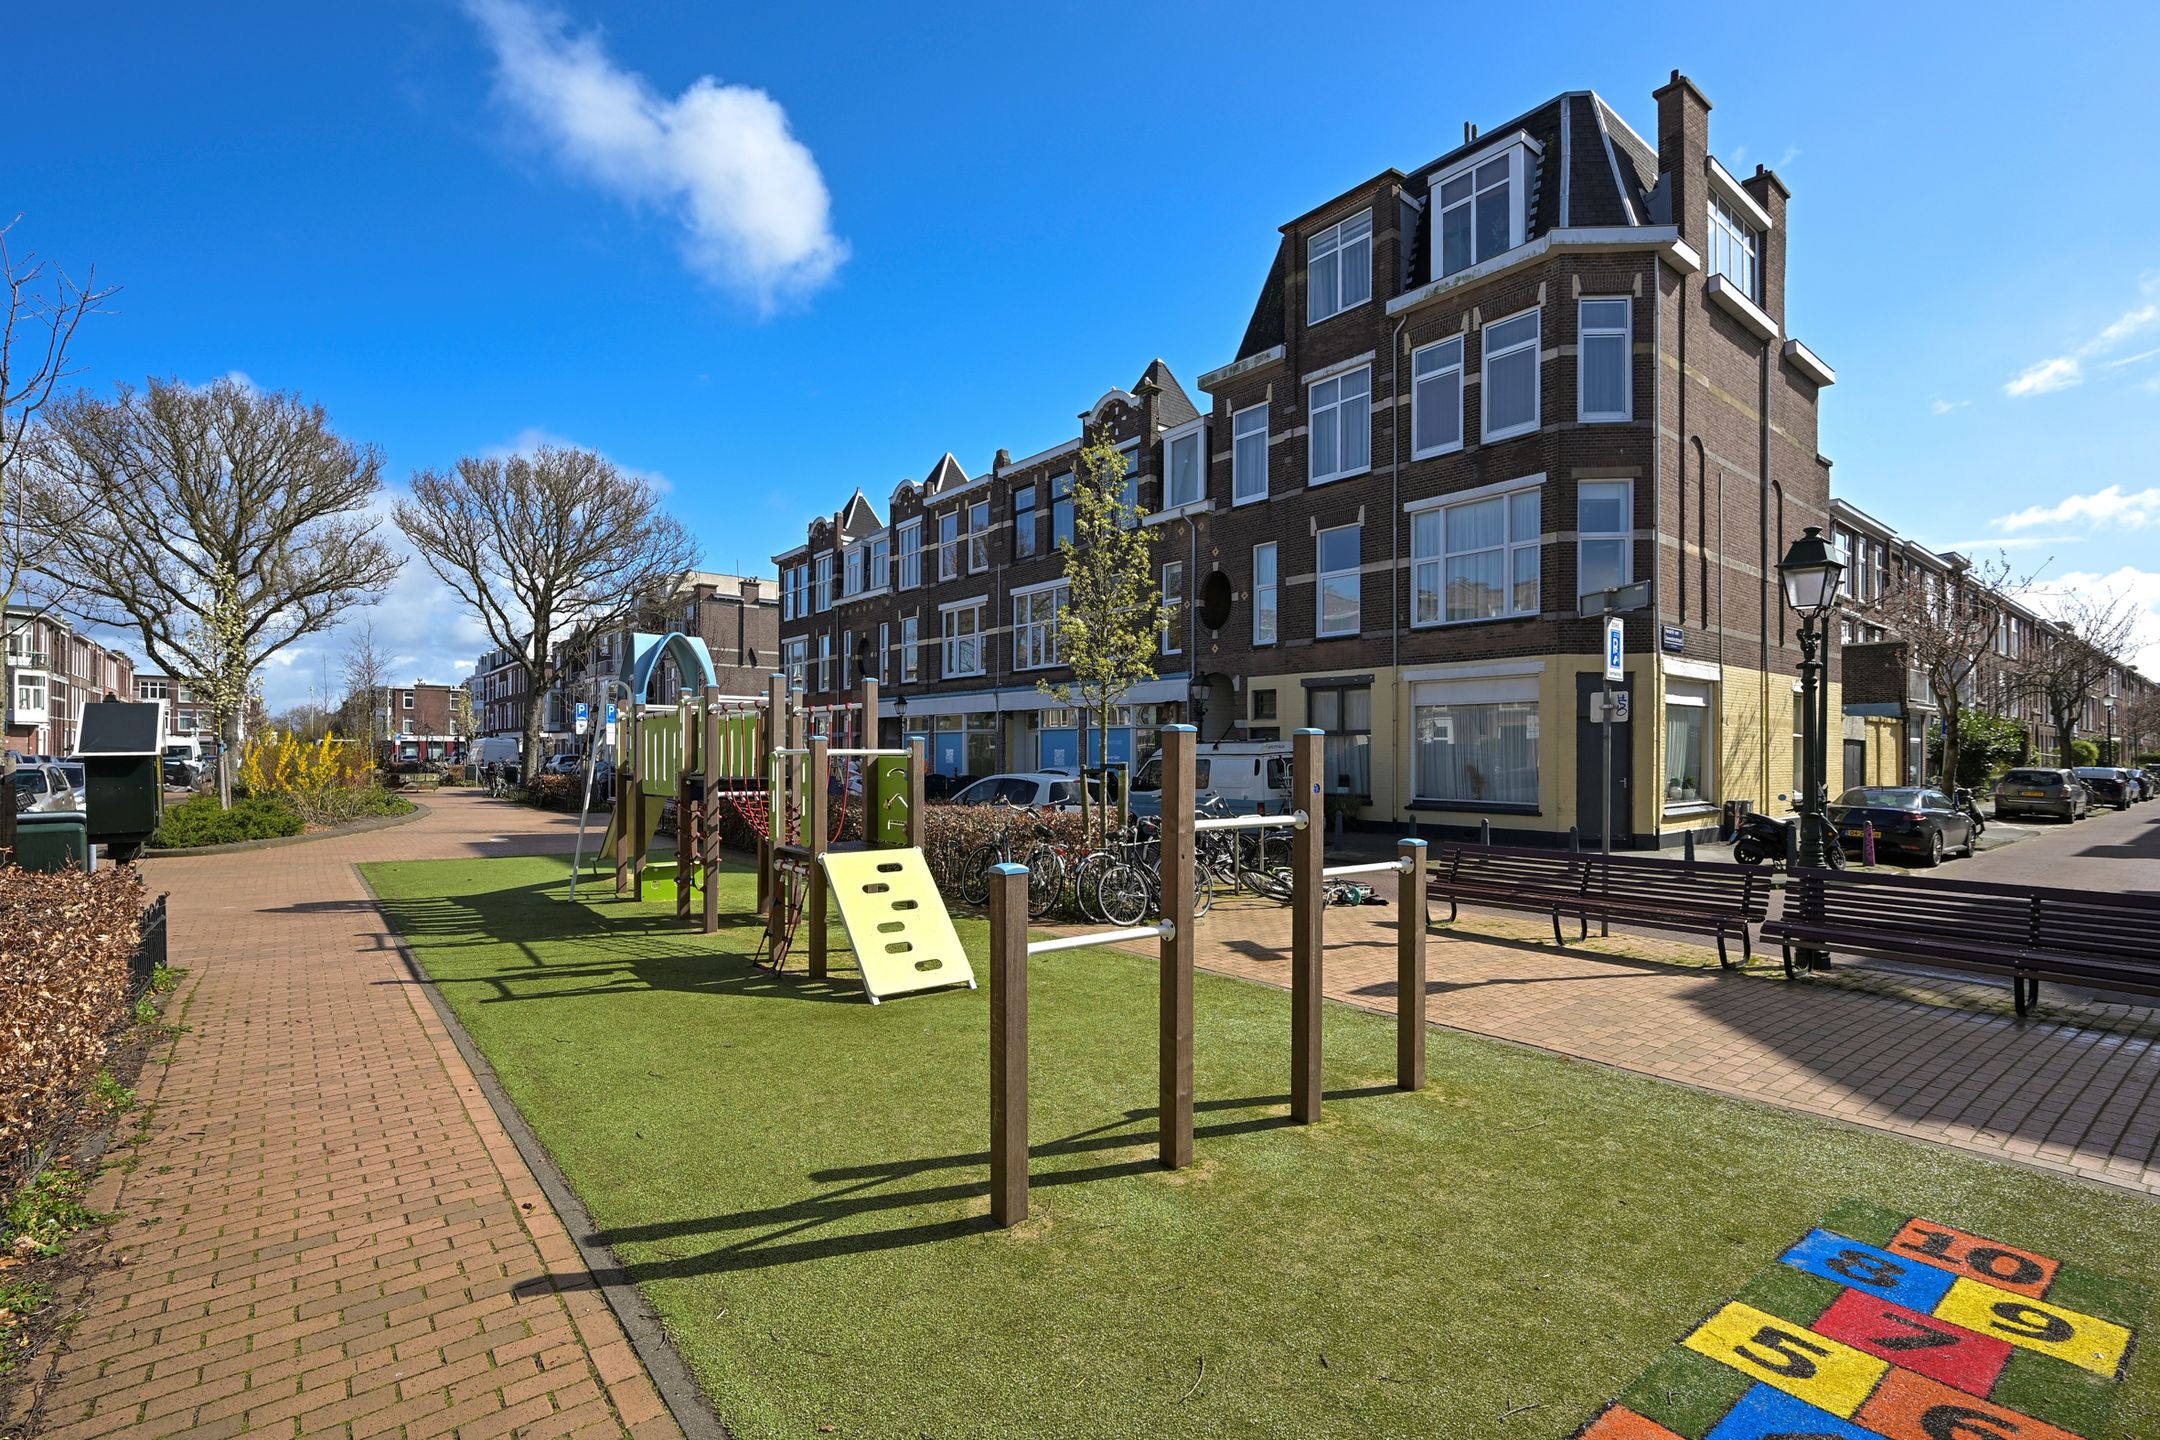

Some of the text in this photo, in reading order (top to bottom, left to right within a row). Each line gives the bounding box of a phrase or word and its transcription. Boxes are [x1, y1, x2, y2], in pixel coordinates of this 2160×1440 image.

[578, 705, 585, 714] P
[608, 705, 615, 717] P
[1824, 1250, 1905, 1288] 8
[1899, 1227, 2044, 1284] 10
[1869, 1311, 1961, 1351] 7
[1990, 1302, 2075, 1343] 9
[1733, 1325, 1834, 1379] 5
